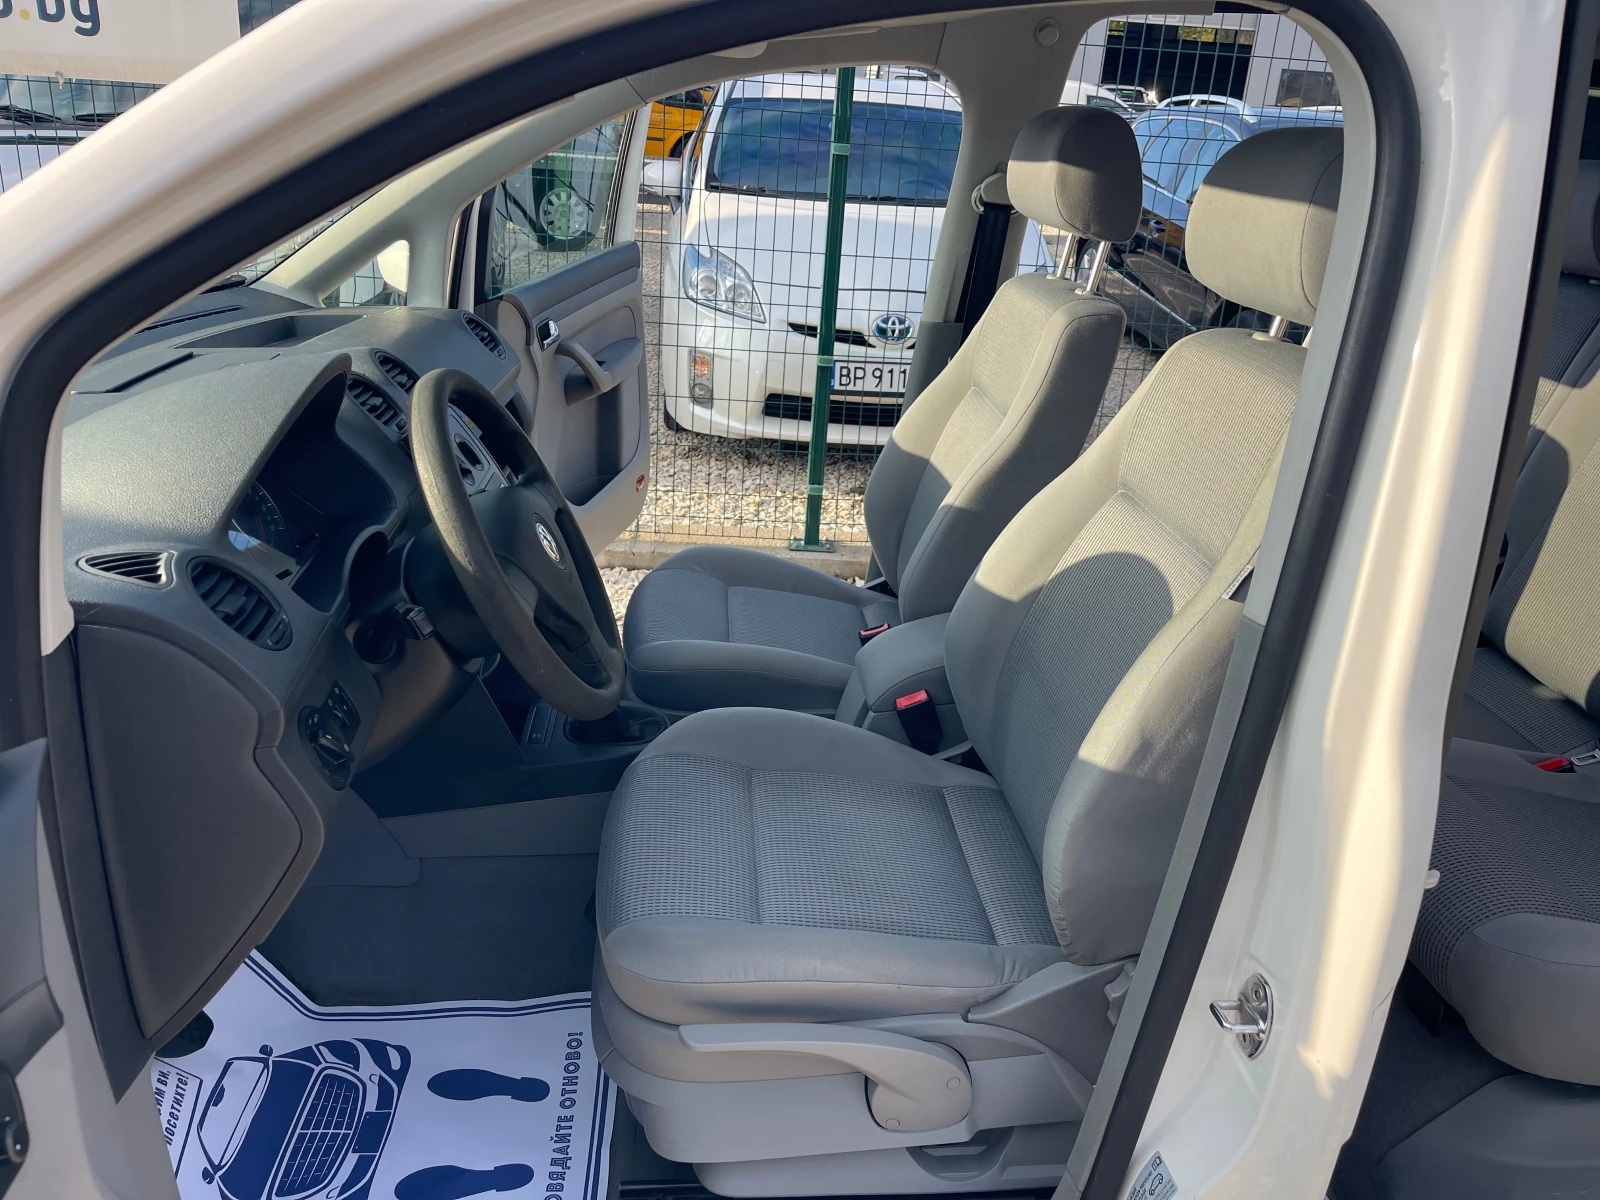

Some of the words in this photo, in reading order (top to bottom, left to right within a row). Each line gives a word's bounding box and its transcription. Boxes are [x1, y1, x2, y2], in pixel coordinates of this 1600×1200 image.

[839, 366, 866, 387] BP
[872, 367, 907, 389] 911
[559, 1031, 583, 1110] ОТНОВО!
